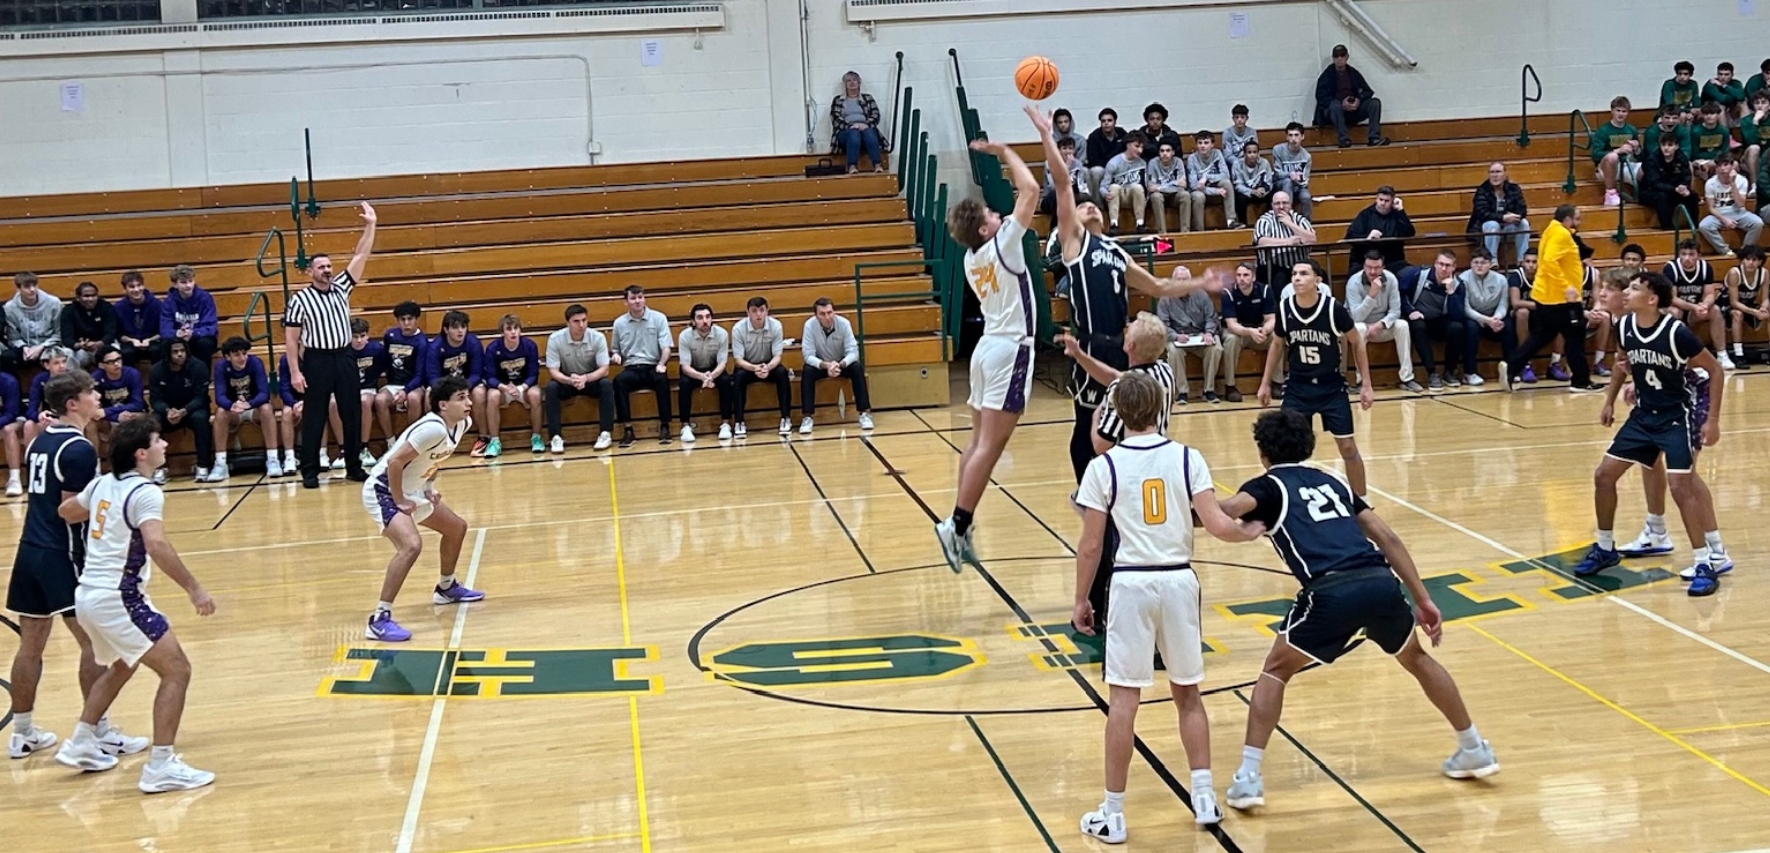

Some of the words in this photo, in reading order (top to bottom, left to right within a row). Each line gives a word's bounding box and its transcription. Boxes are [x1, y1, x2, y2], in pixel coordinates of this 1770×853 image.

[971, 262, 999, 299] 24
[1111, 269, 1121, 294] 1
[1290, 329, 1331, 346] SPARTANS
[1299, 345, 1321, 365] 15
[1627, 348, 1673, 370] SPARTANS
[1645, 369, 1662, 390] 4
[28, 453, 48, 494] 13
[1142, 477, 1168, 525] 0
[1298, 483, 1350, 522] 21
[91, 499, 112, 540] 5
